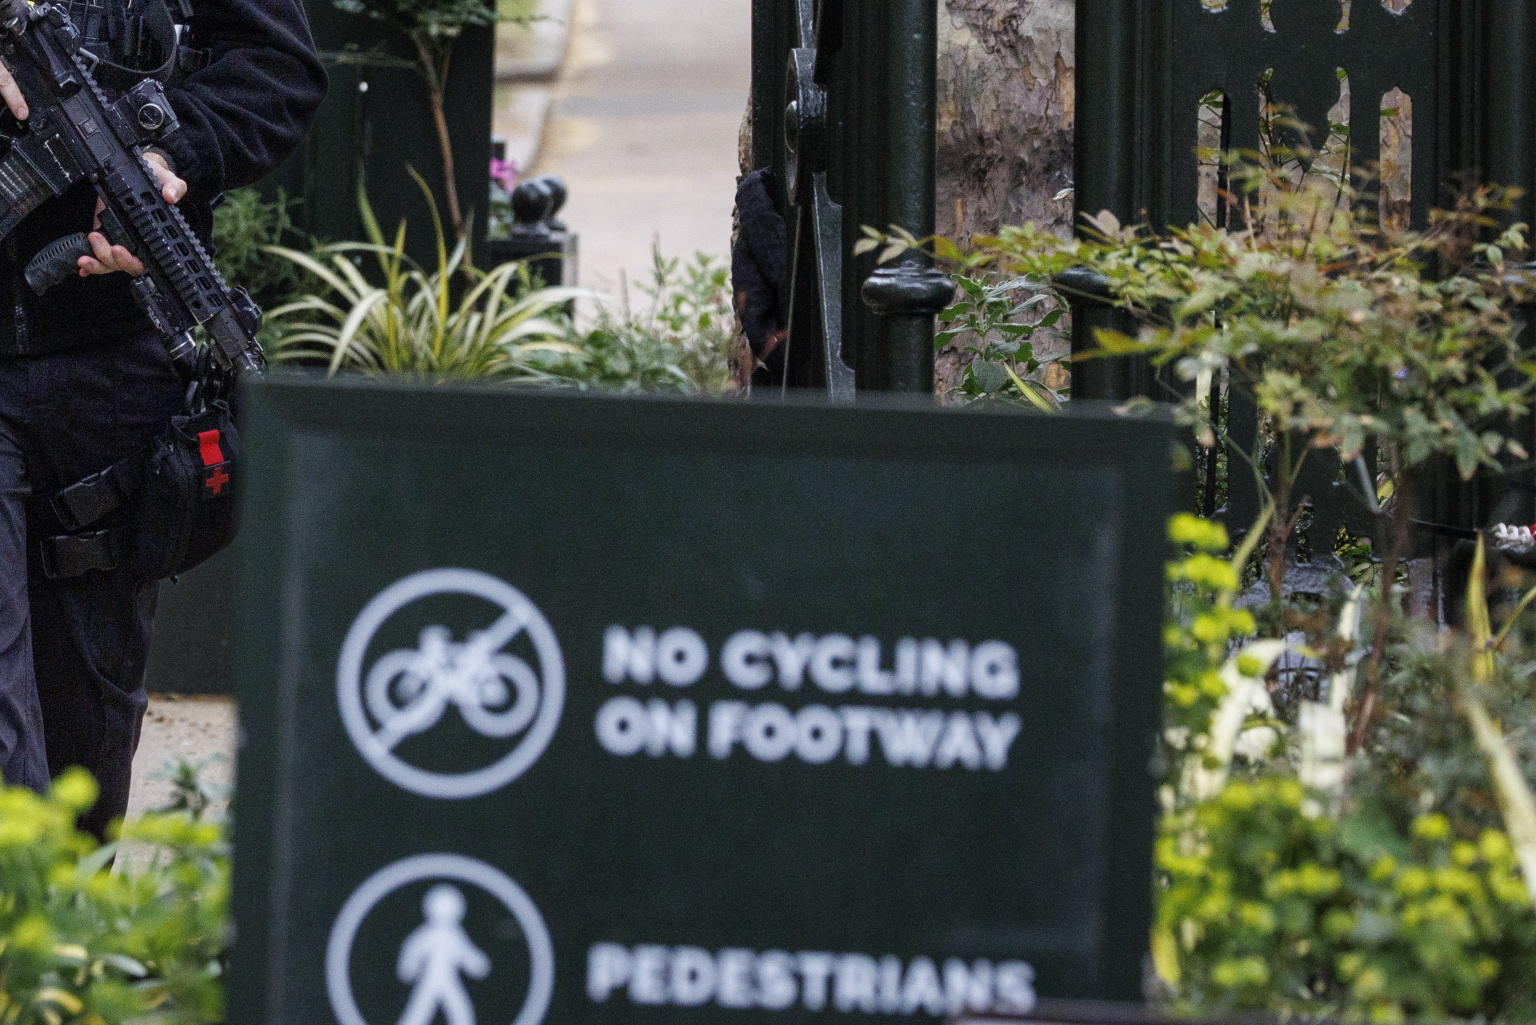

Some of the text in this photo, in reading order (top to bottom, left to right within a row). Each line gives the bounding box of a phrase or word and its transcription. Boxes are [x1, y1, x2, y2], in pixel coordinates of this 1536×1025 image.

[602, 624, 1021, 700] NO CYCLING
[595, 696, 1022, 771] ON FOOTWAY
[585, 941, 1038, 1016] PEDESTRIANS
